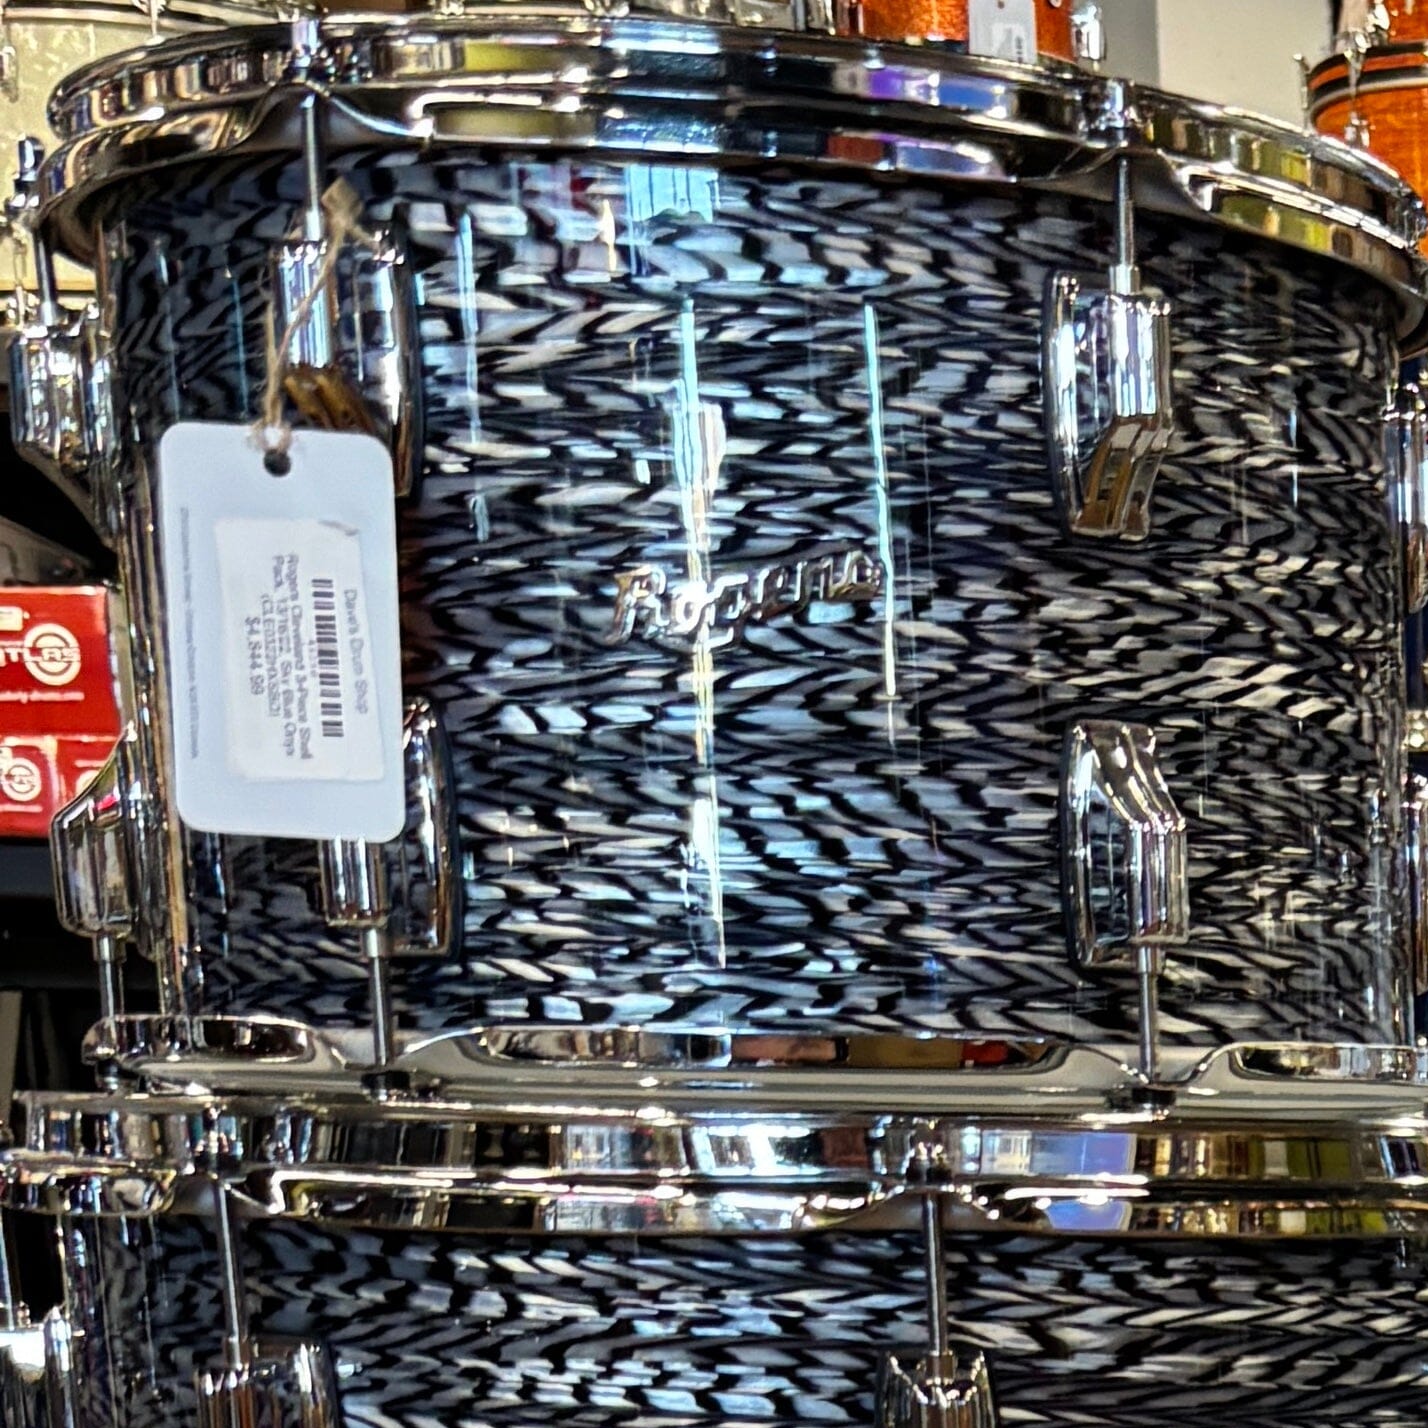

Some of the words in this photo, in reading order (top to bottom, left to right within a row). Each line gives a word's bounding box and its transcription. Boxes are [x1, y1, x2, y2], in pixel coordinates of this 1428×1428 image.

[344, 589, 360, 634] Dave's
[350, 637, 365, 676] Drum
[354, 679, 369, 714] Shop
